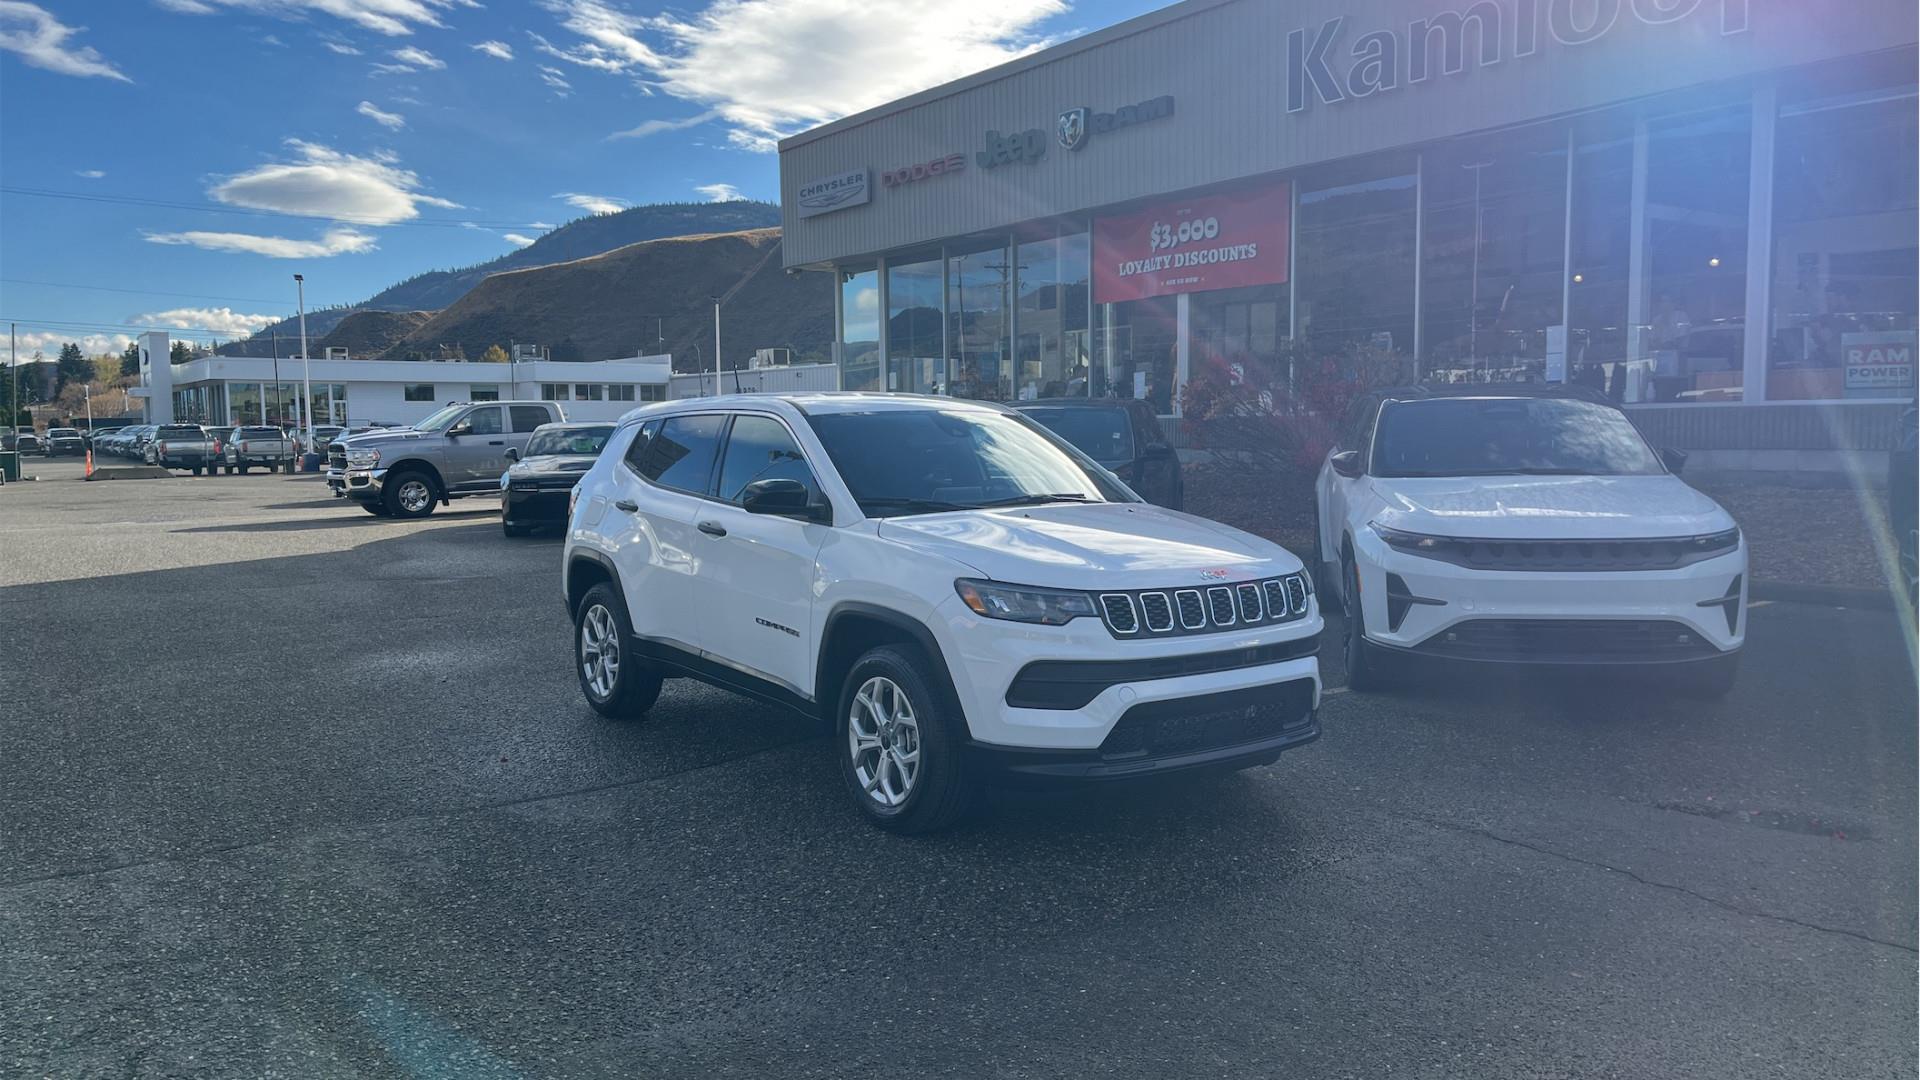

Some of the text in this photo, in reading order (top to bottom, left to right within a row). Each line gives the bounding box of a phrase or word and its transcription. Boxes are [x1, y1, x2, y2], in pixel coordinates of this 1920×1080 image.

[1286, 0, 1749, 114] Kamlo
[1089, 95, 1175, 136] RAM
[975, 128, 1047, 169] Jeep
[799, 174, 864, 199] CHRYSLER
[881, 153, 967, 188] DODGE
[1151, 216, 1219, 253] $3,000
[1118, 243, 1258, 277] LOYALTY DISCOUNTS
[1847, 347, 1910, 364] RAM
[1848, 367, 1910, 378] POWER
[755, 617, 801, 638] COMPASS
